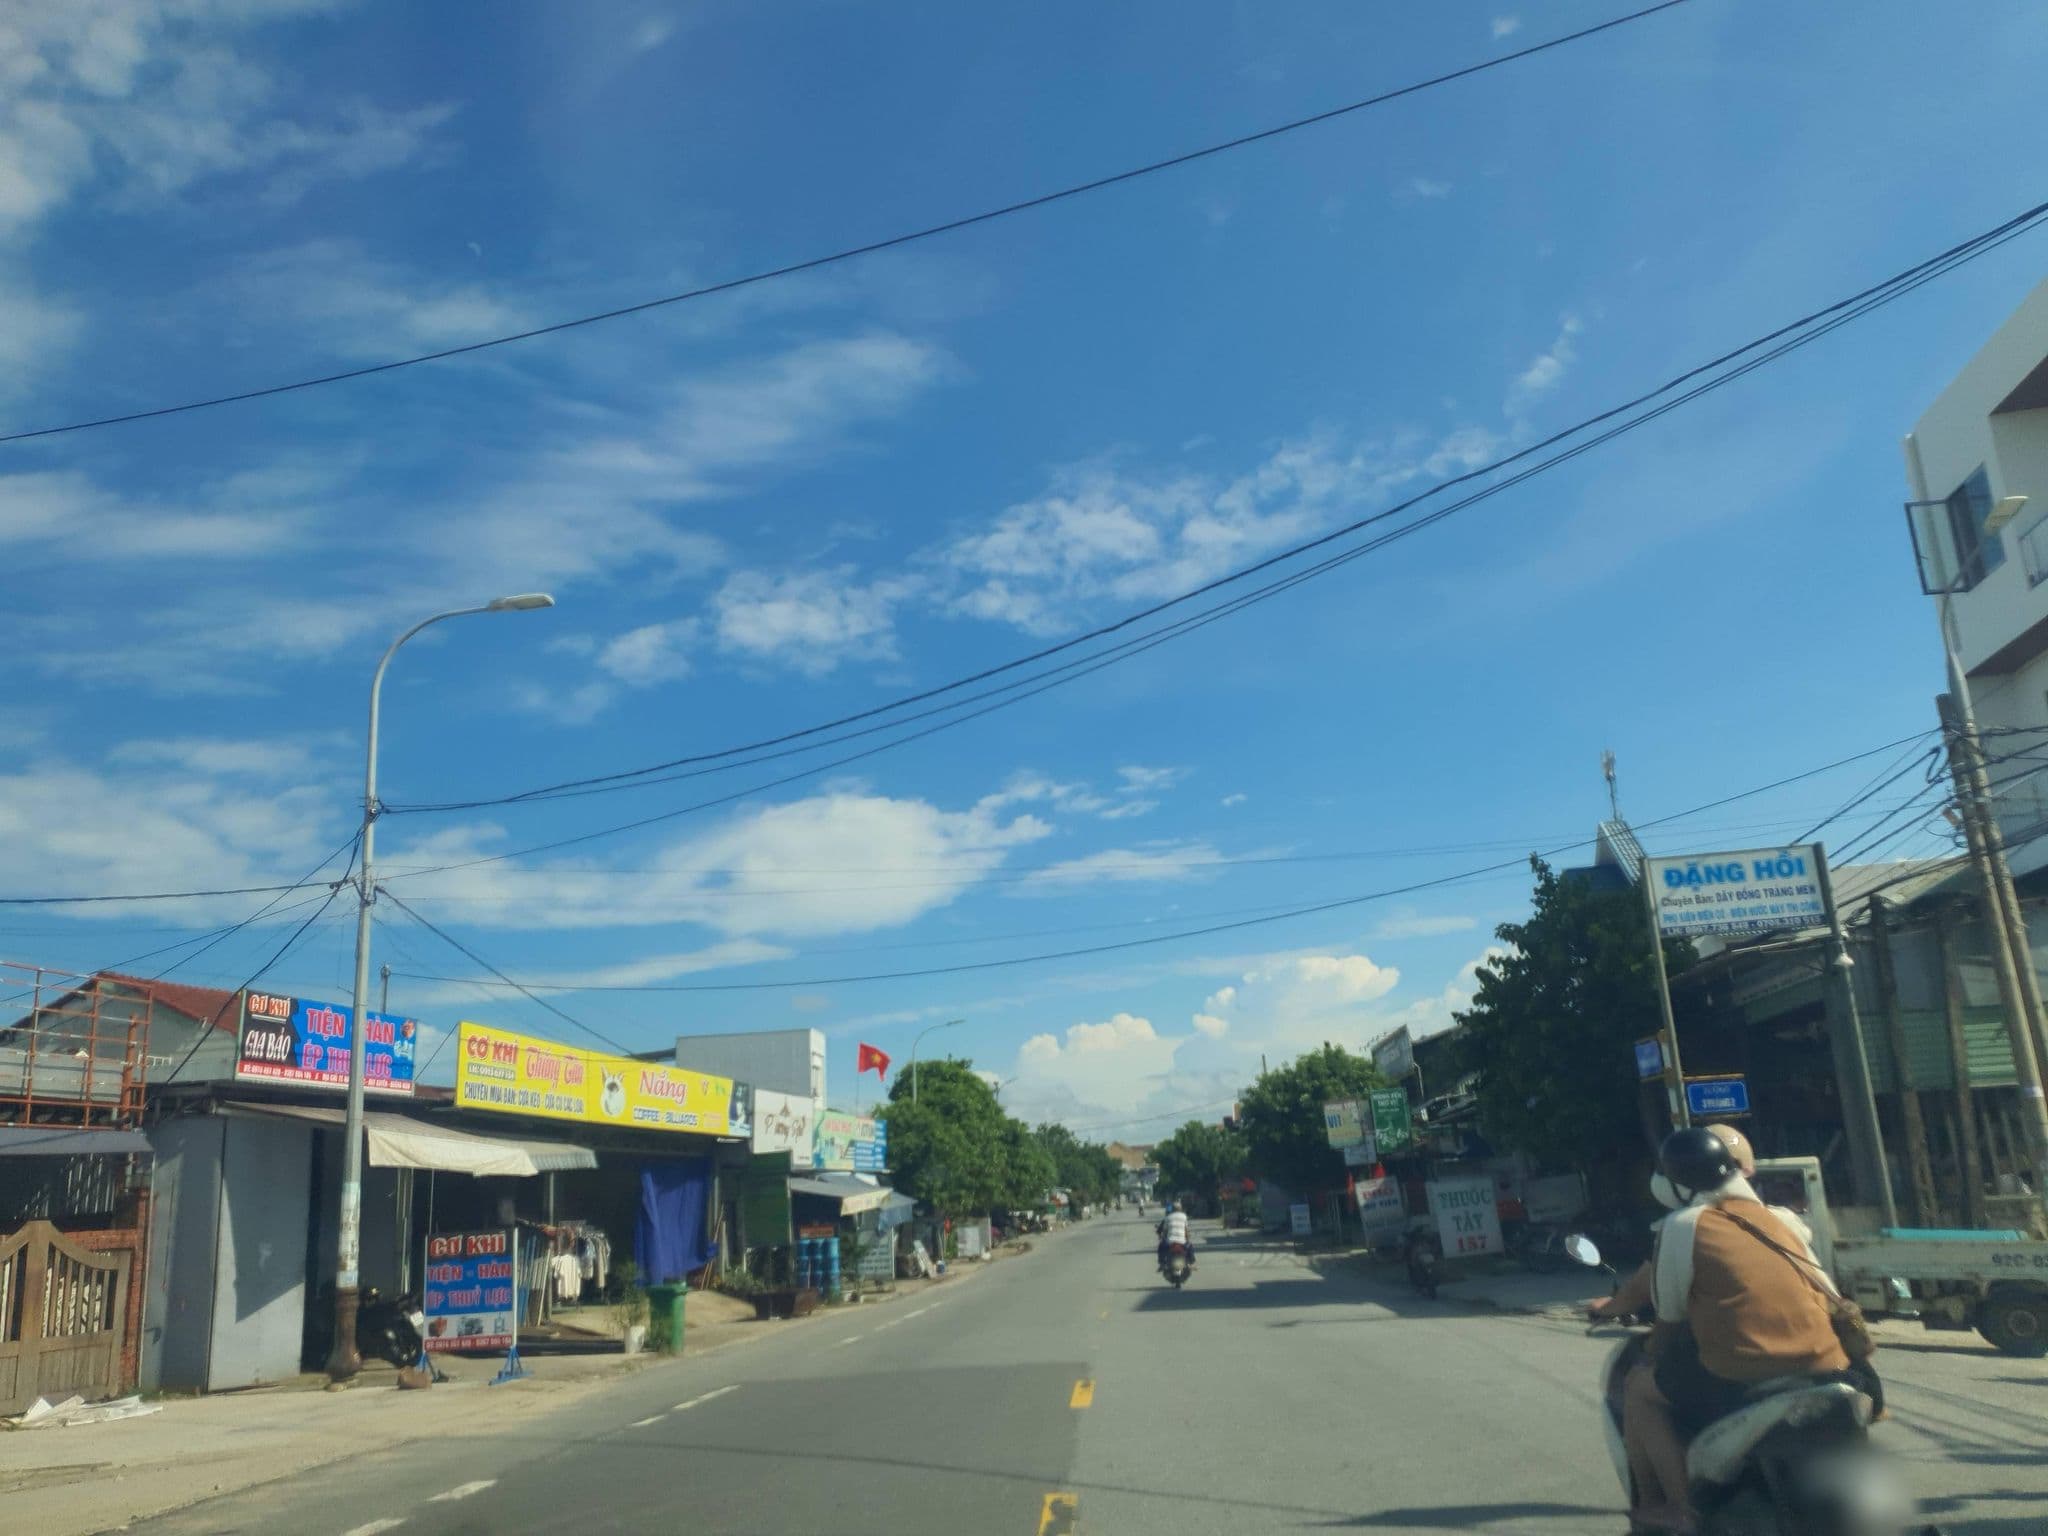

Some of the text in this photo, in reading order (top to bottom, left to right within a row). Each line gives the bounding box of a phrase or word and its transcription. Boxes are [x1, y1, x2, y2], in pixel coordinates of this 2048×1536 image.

[1663, 850, 1806, 891] ĐẶNG HỒI
[306, 1006, 346, 1041] TIỆN
[245, 1030, 266, 1058] GIA
[303, 1038, 323, 1069] ÉP
[467, 1034, 489, 1060] CƠ
[492, 1036, 519, 1064] KHÍ
[640, 1069, 687, 1106] Nắng
[429, 1231, 507, 1257] CƠ KHÍ
[427, 1260, 512, 1284] TIỆN HÀN
